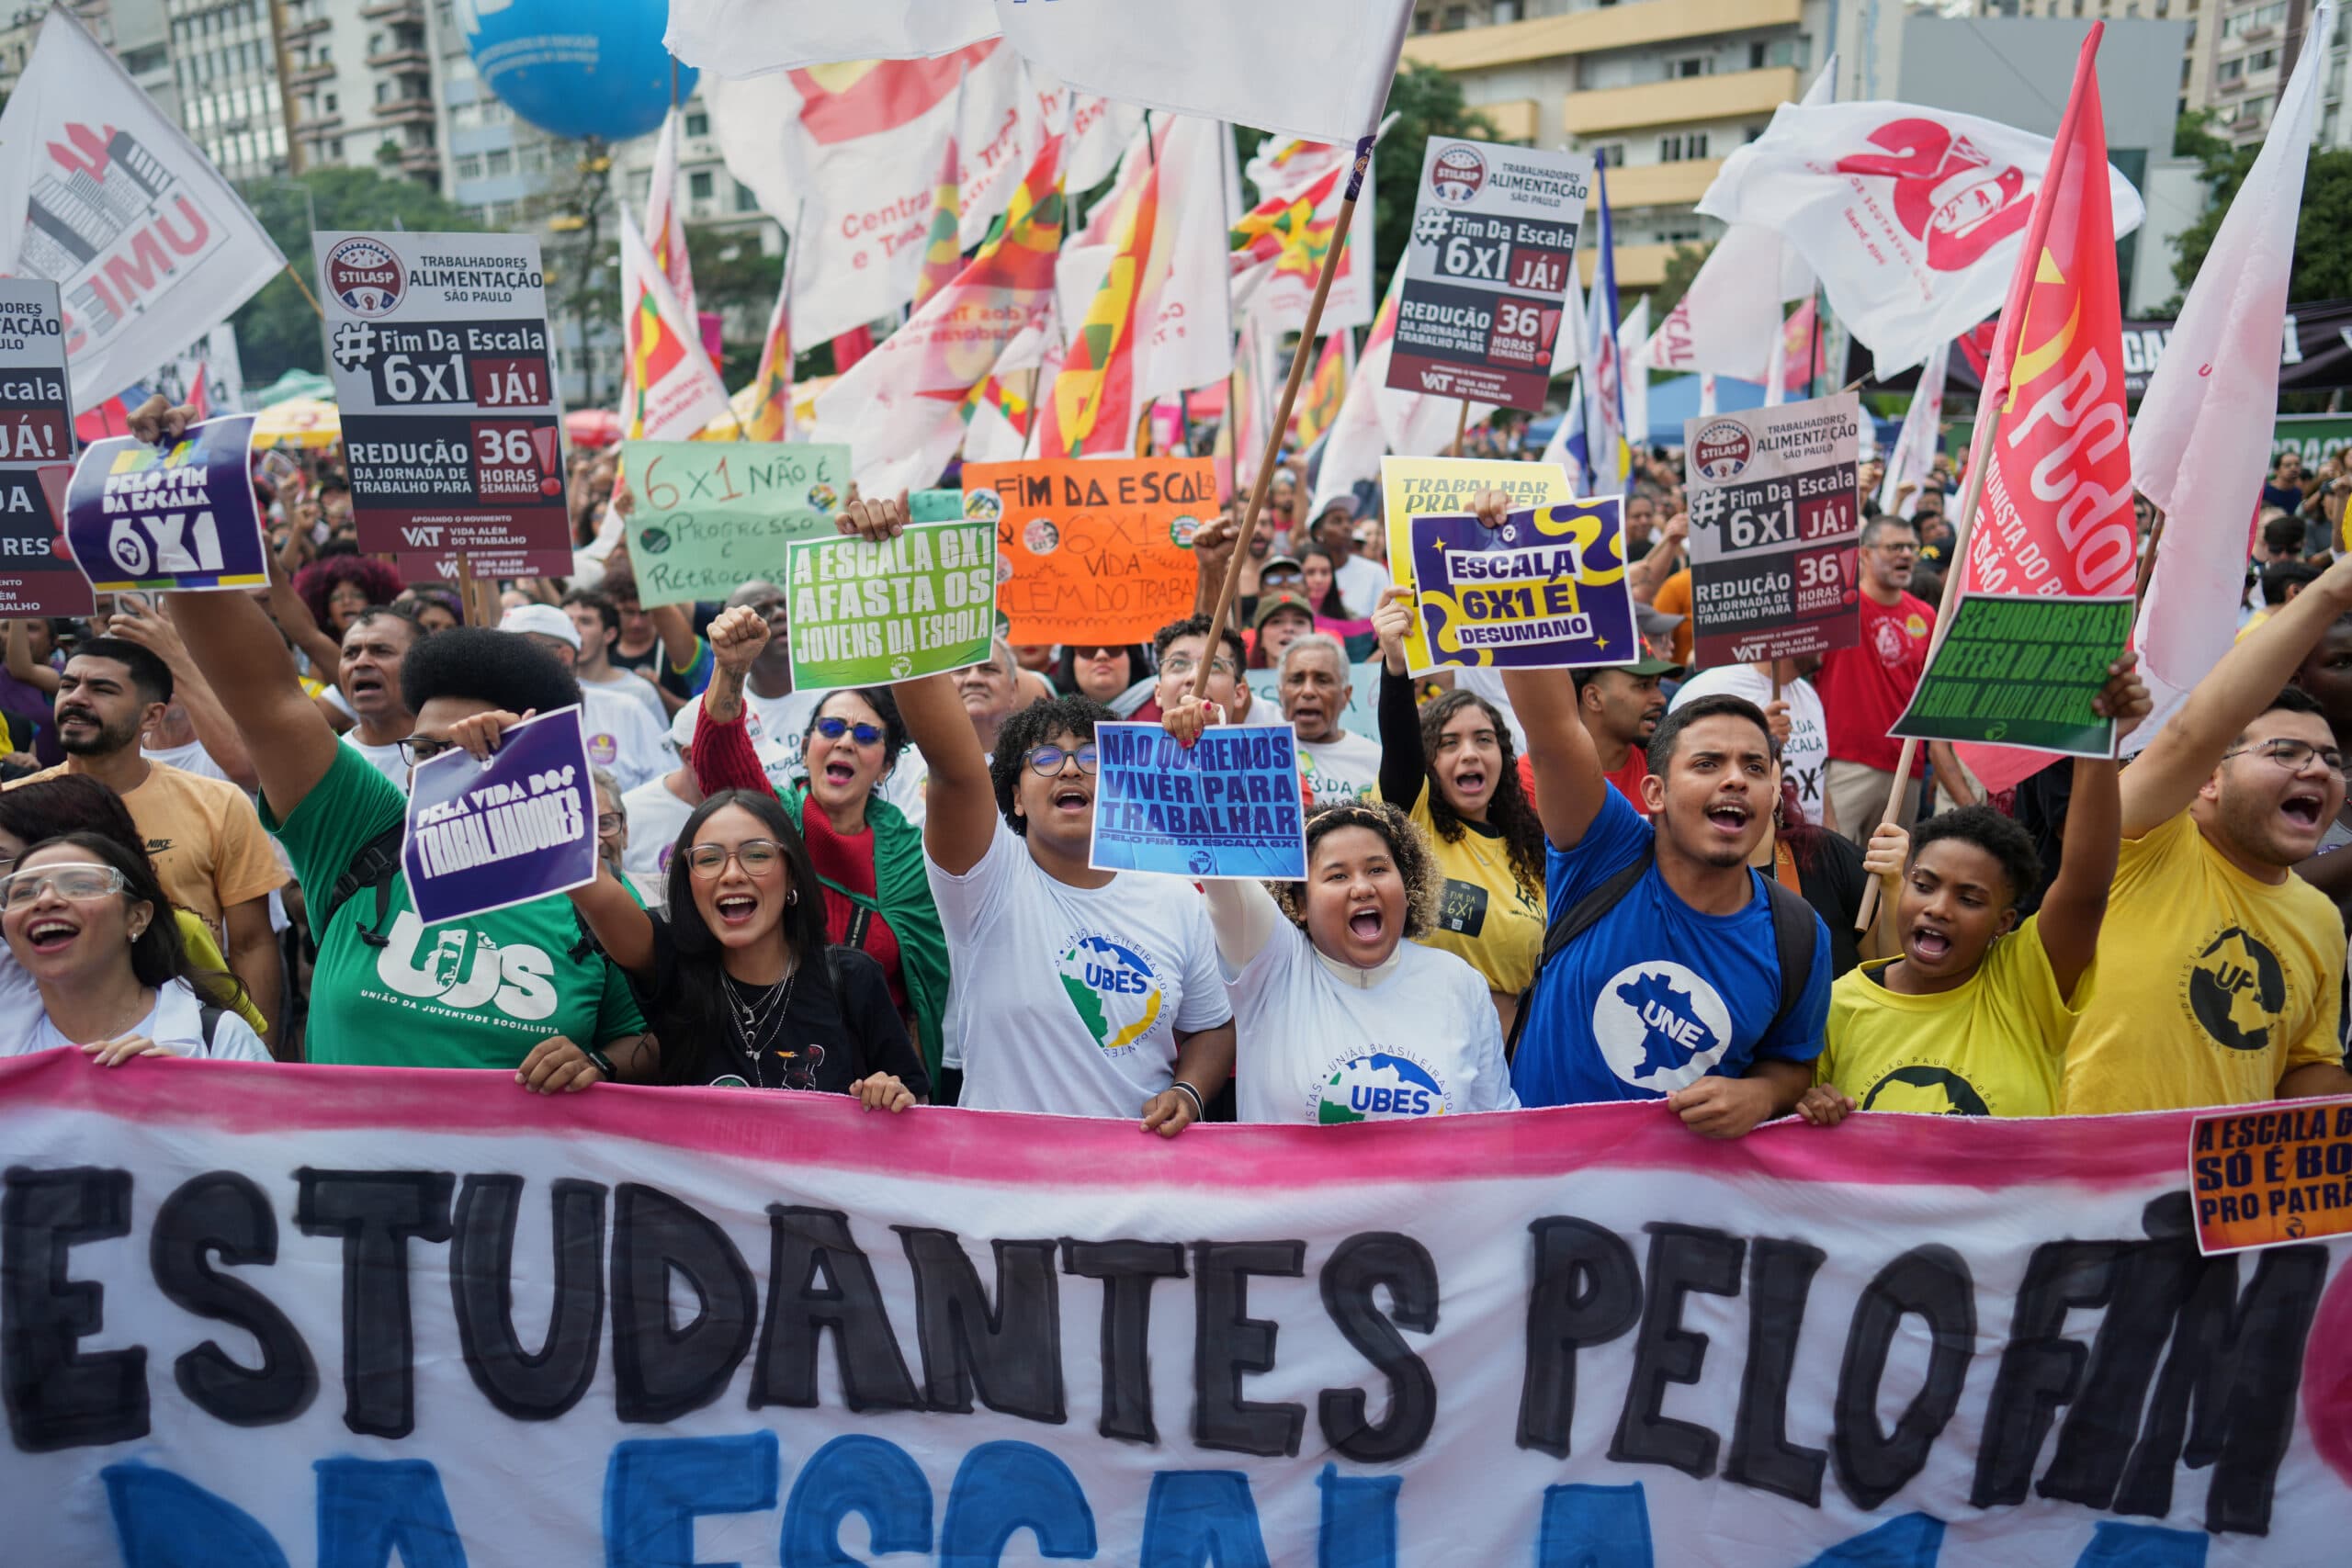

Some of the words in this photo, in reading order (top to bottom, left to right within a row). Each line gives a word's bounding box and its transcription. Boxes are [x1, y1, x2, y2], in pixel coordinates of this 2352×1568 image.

[1488, 173, 1589, 200] ALIMENTAÇÃO
[1502, 163, 1580, 182] TRABALHADORES
[1510, 191, 1530, 202] SÃO
[1531, 194, 1561, 208] PAULO
[1487, 220, 1511, 240] Da
[1516, 224, 1574, 249] Escala
[420, 255, 528, 268] TRABALHADORES
[1444, 237, 1511, 279] 6x1
[1515, 254, 1560, 290] JÁ!
[338, 270, 394, 284] STILASP
[409, 267, 543, 290] ALIMENTAÇÃO
[444, 289, 469, 302] SÃO
[472, 291, 513, 302] PAULO
[0, 313, 61, 338] AÇÃO
[1400, 300, 1491, 330] REDUÇÃO
[1497, 303, 1540, 337] 36
[426, 328, 460, 351] Da
[466, 327, 545, 351] Escala
[1396, 331, 1453, 349] TRABALHO
[1454, 340, 1485, 354] PARA
[1400, 320, 1416, 331] DA
[1417, 321, 1467, 340] JORNADA
[1469, 331, 1485, 343] DE
[1491, 336, 1536, 351] HORAS
[1489, 347, 1534, 363] SEMANAIS
[382, 354, 470, 401] 6x1
[485, 362, 540, 404] JÁ!
[1469, 389, 1512, 401] TRABALHO
[1767, 412, 1848, 434] TRABALHADORES
[347, 438, 469, 467] REDUÇÃO
[478, 429, 532, 465] 36
[1701, 444, 1746, 460] STILASP
[1782, 448, 1801, 461] SÃO
[1804, 444, 1834, 457] PAULO
[104, 470, 163, 495] PELO
[163, 465, 209, 489] FIM
[353, 468, 374, 479] DA
[377, 468, 445, 480] JORNADA
[448, 468, 469, 479] DE
[353, 480, 429, 493] TRABALHO
[434, 480, 472, 493] PARA
[480, 469, 537, 482] HORAS
[480, 482, 539, 493] SEMANAIS
[749, 455, 807, 494] NÃO
[995, 473, 1052, 507] FIM
[1064, 475, 1110, 506] DA
[1118, 469, 1216, 504] ESCALA
[1767, 483, 1792, 502] Da
[1798, 468, 1856, 498] Escala
[103, 494, 129, 514] DA
[131, 487, 212, 511] ESCALA
[1405, 493, 1460, 513] PRA
[449, 527, 475, 536] VIDA
[478, 525, 507, 536] ALÉM
[463, 514, 512, 523] MOVIMENTO
[662, 512, 814, 543] PROGRESSO
[1729, 501, 1796, 548] 6x1
[1806, 500, 1848, 538] JÁ!
[108, 511, 225, 576] 6X1
[401, 526, 445, 547] VAT
[450, 537, 466, 546] DO
[469, 536, 526, 545] TRABALHO
[793, 547, 813, 585] A
[819, 531, 934, 581] ESCALA
[938, 525, 991, 570] 6X1
[1084, 548, 1141, 577] VIDA
[1450, 549, 1577, 580] ESCALA
[2015, 541, 2051, 581] DO
[1798, 553, 1838, 588] 36
[794, 574, 936, 625] AFASTA
[943, 568, 991, 608] OS
[1094, 582, 1129, 613] DO
[1462, 586, 1536, 620] 6X1
[1542, 570, 1573, 615] É
[1695, 571, 1792, 603] REDUÇÃO
[1797, 585, 1840, 603] HORAS
[1697, 610, 1758, 626] TRABALHO
[1760, 604, 1792, 617] PARA
[1699, 604, 1713, 615] DA
[1716, 596, 1771, 612] JORNADA
[1773, 592, 1789, 604] DE
[1796, 596, 1841, 612] SEMANAIS
[796, 621, 883, 664] JOVENS
[886, 618, 916, 656] DA
[919, 606, 989, 650] ESCOLA
[1459, 616, 1588, 645] DESUMANO
[1770, 640, 1791, 649] VIDA
[1731, 643, 1767, 662] VAT
[1770, 649, 1783, 658] DO
[1785, 640, 1829, 655] TRABALHO
[1930, 639, 2018, 680] DEFESA
[1103, 729, 1154, 768] NÃO
[1155, 735, 1292, 774] QUEREMOS
[416, 795, 470, 829] PELA
[469, 779, 527, 810] VIDA
[528, 764, 576, 795] DOS
[1104, 770, 1194, 804] VIVER
[1202, 773, 1295, 805] PARA
[1102, 800, 1298, 835] TRABALHAR
[147, 839, 173, 849] NIKE
[414, 786, 585, 880] TRABALHADORES
[1099, 832, 1142, 843] PELO
[1145, 835, 1174, 846] FIM
[1177, 837, 1200, 847] DA
[1203, 838, 1269, 848] ESCALA
[1270, 840, 1300, 849] 6X1
[1085, 962, 1148, 995] UBES
[360, 989, 399, 1005] UNIÃO
[401, 999, 417, 1010] DA
[423, 1005, 489, 1024] JUVENTUDE
[492, 1017, 560, 1035] SOCIALISTA
[1642, 998, 1705, 1050] UNE
[1351, 1084, 1430, 1116] UBES
[2197, 1121, 2213, 1152] A
[2222, 1109, 2327, 1150] ESCALA
[2196, 1148, 2254, 1191] SÓ
[2264, 1145, 2286, 1183] É
[2199, 1192, 2260, 1226] PRO
[0, 1167, 1439, 1463] ESTUDANTES
[1516, 1214, 1979, 1513] PELO
[1969, 1190, 2330, 1537] FIM
